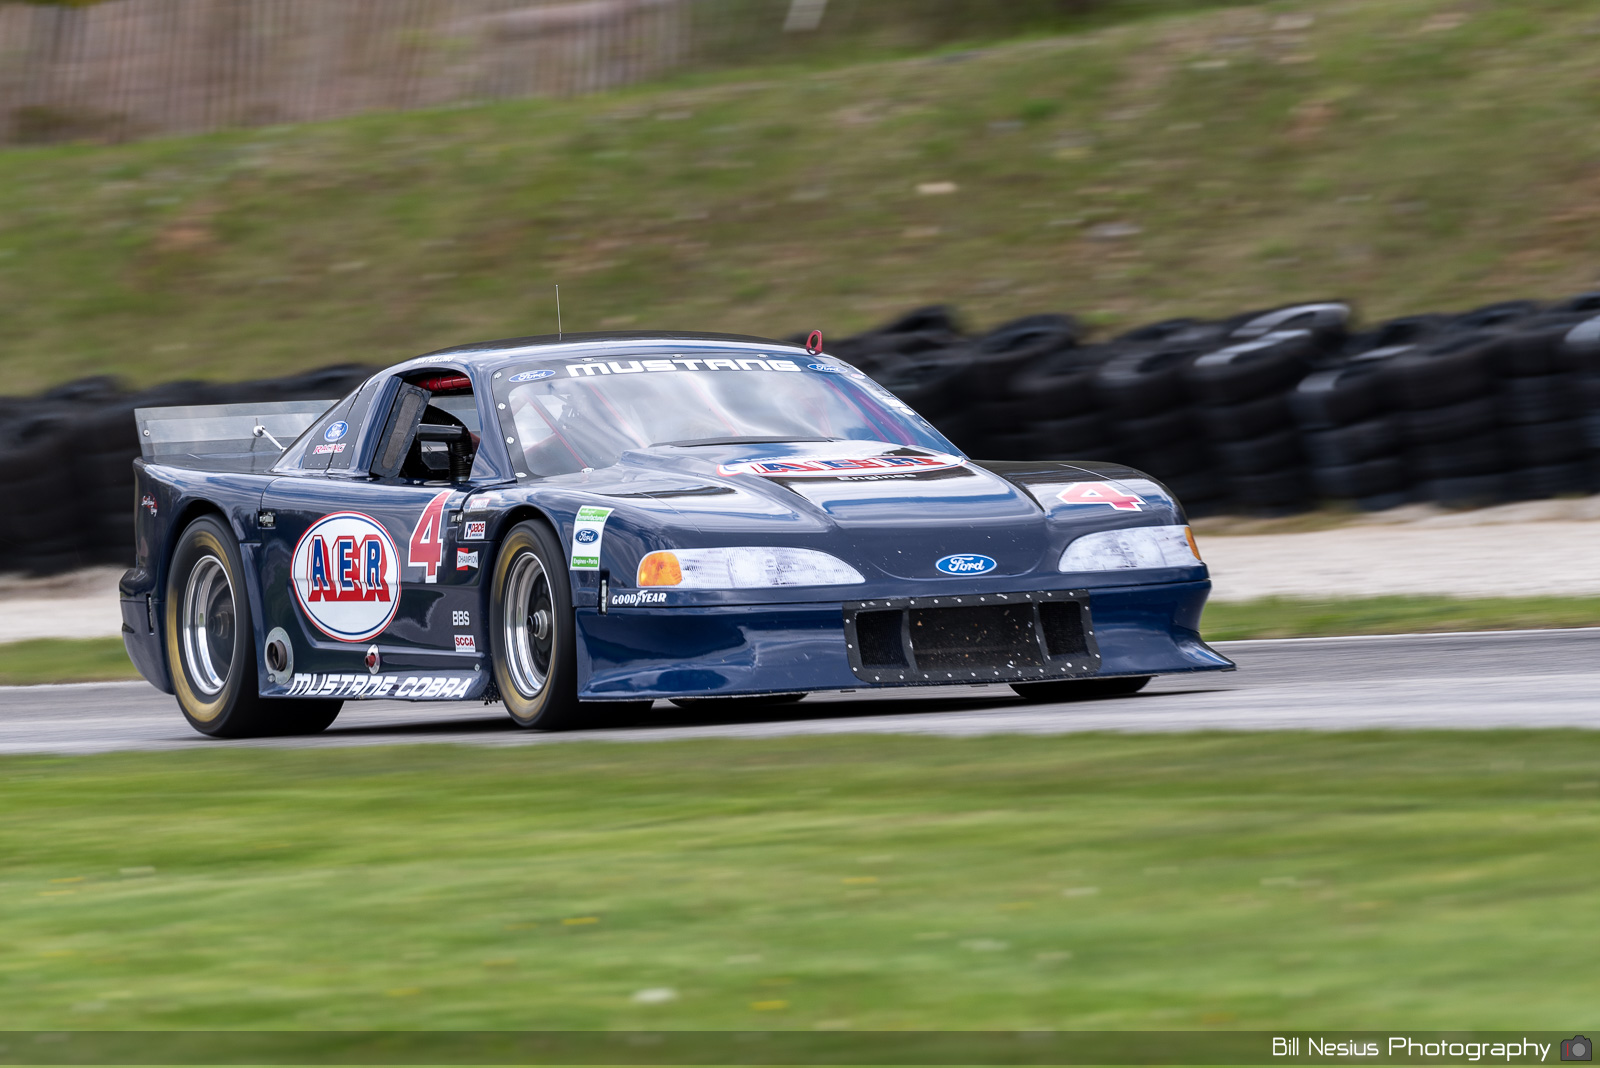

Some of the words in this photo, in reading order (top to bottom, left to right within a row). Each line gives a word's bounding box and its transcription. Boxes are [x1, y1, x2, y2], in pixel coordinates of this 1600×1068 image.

[566, 358, 801, 377] MUSTANG
[812, 363, 842, 373] Ford
[516, 371, 549, 382] Ford
[326, 423, 345, 439] Ford
[313, 443, 346, 454] RACING
[751, 457, 946, 473] AER
[836, 473, 916, 481] Engines
[1056, 482, 1146, 511] 4
[408, 489, 458, 584] 4
[470, 523, 484, 534] pace
[577, 530, 596, 542] Ford
[458, 555, 478, 564] CHAMPION
[944, 555, 989, 572] Ford
[308, 535, 391, 602] AER
[612, 590, 667, 606] GOODYEAR
[452, 610, 470, 626] BBS
[455, 636, 475, 647] SCCA
[286, 673, 398, 696] MUSTANG
[394, 676, 472, 698] COBRA
